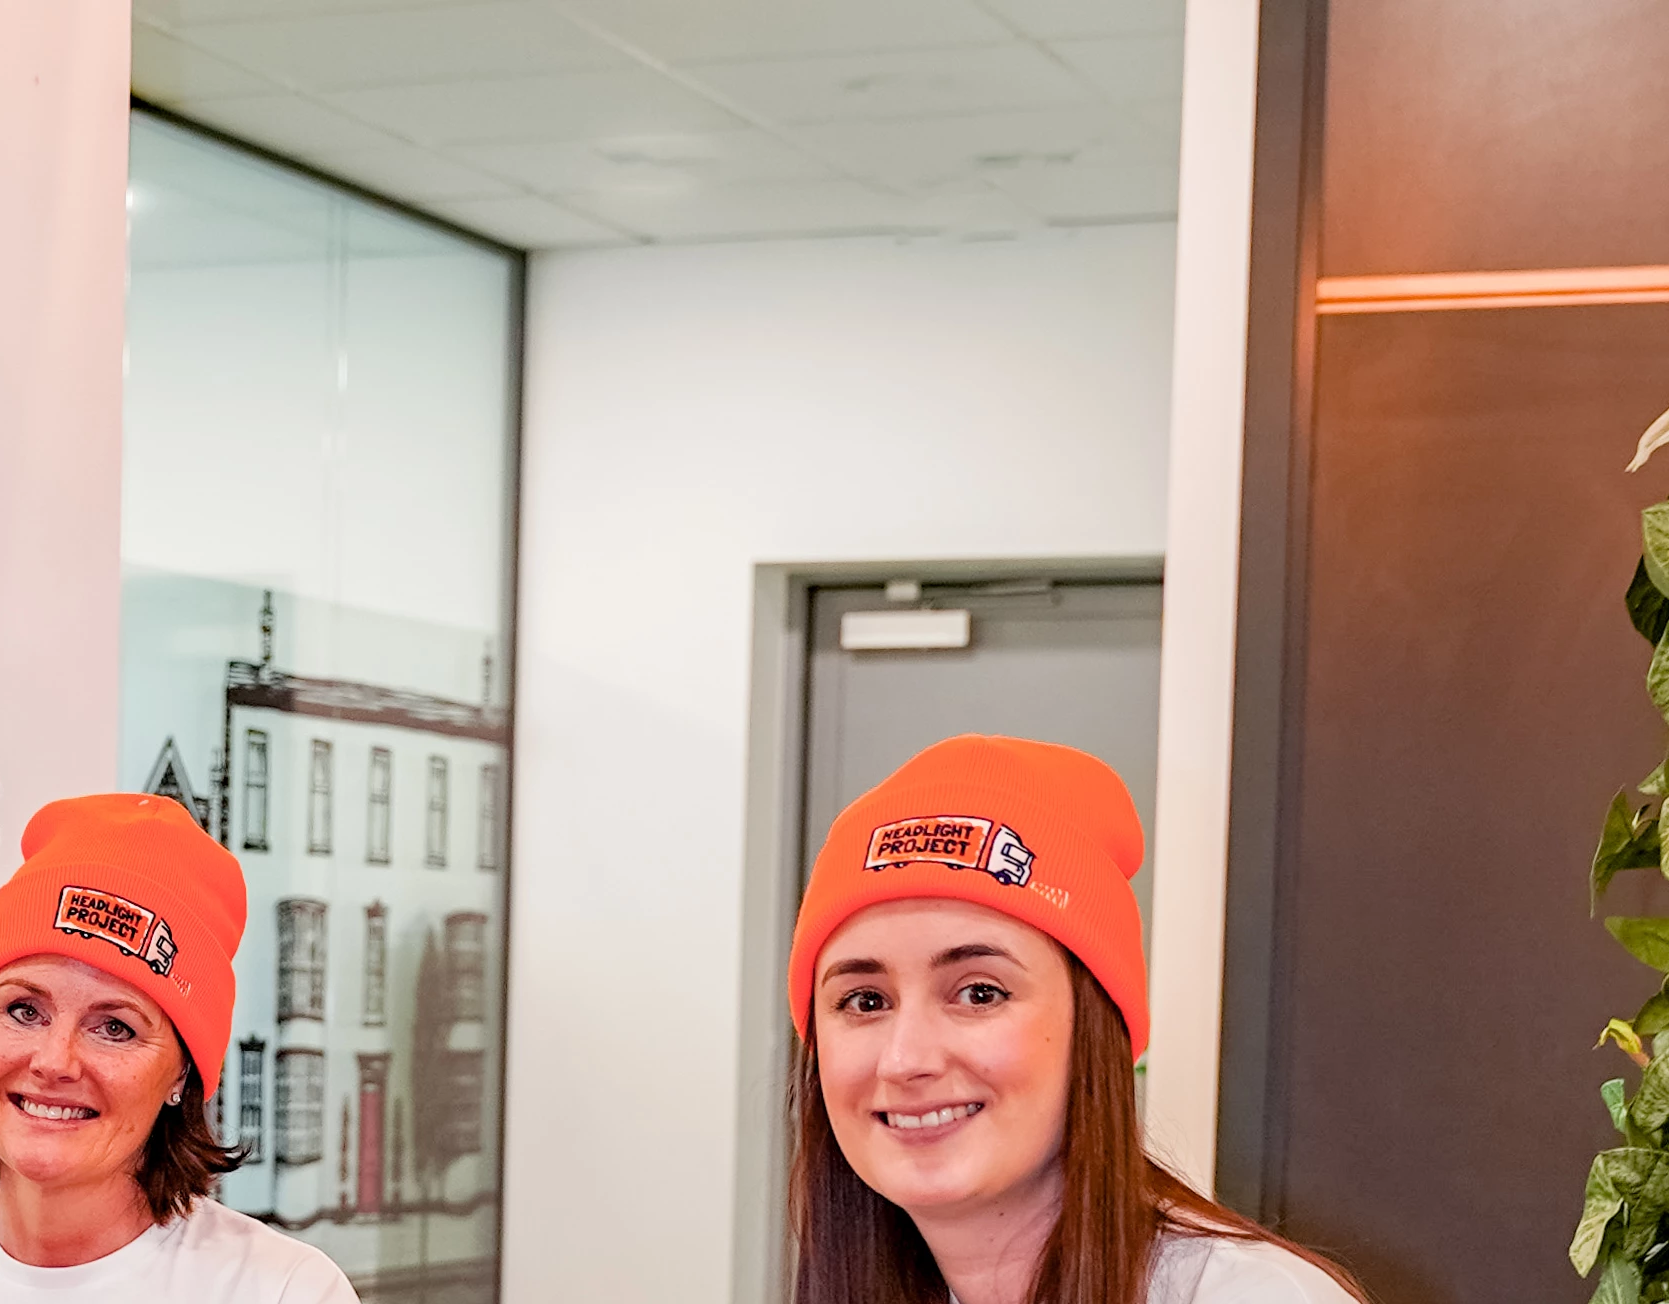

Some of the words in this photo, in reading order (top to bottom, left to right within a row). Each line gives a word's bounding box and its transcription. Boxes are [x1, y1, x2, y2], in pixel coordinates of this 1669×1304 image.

[882, 823, 975, 841] HEADLIGHT
[877, 838, 971, 857] PROJECT
[70, 893, 143, 927] HEADLIGHT
[66, 906, 139, 942] PROJECT
